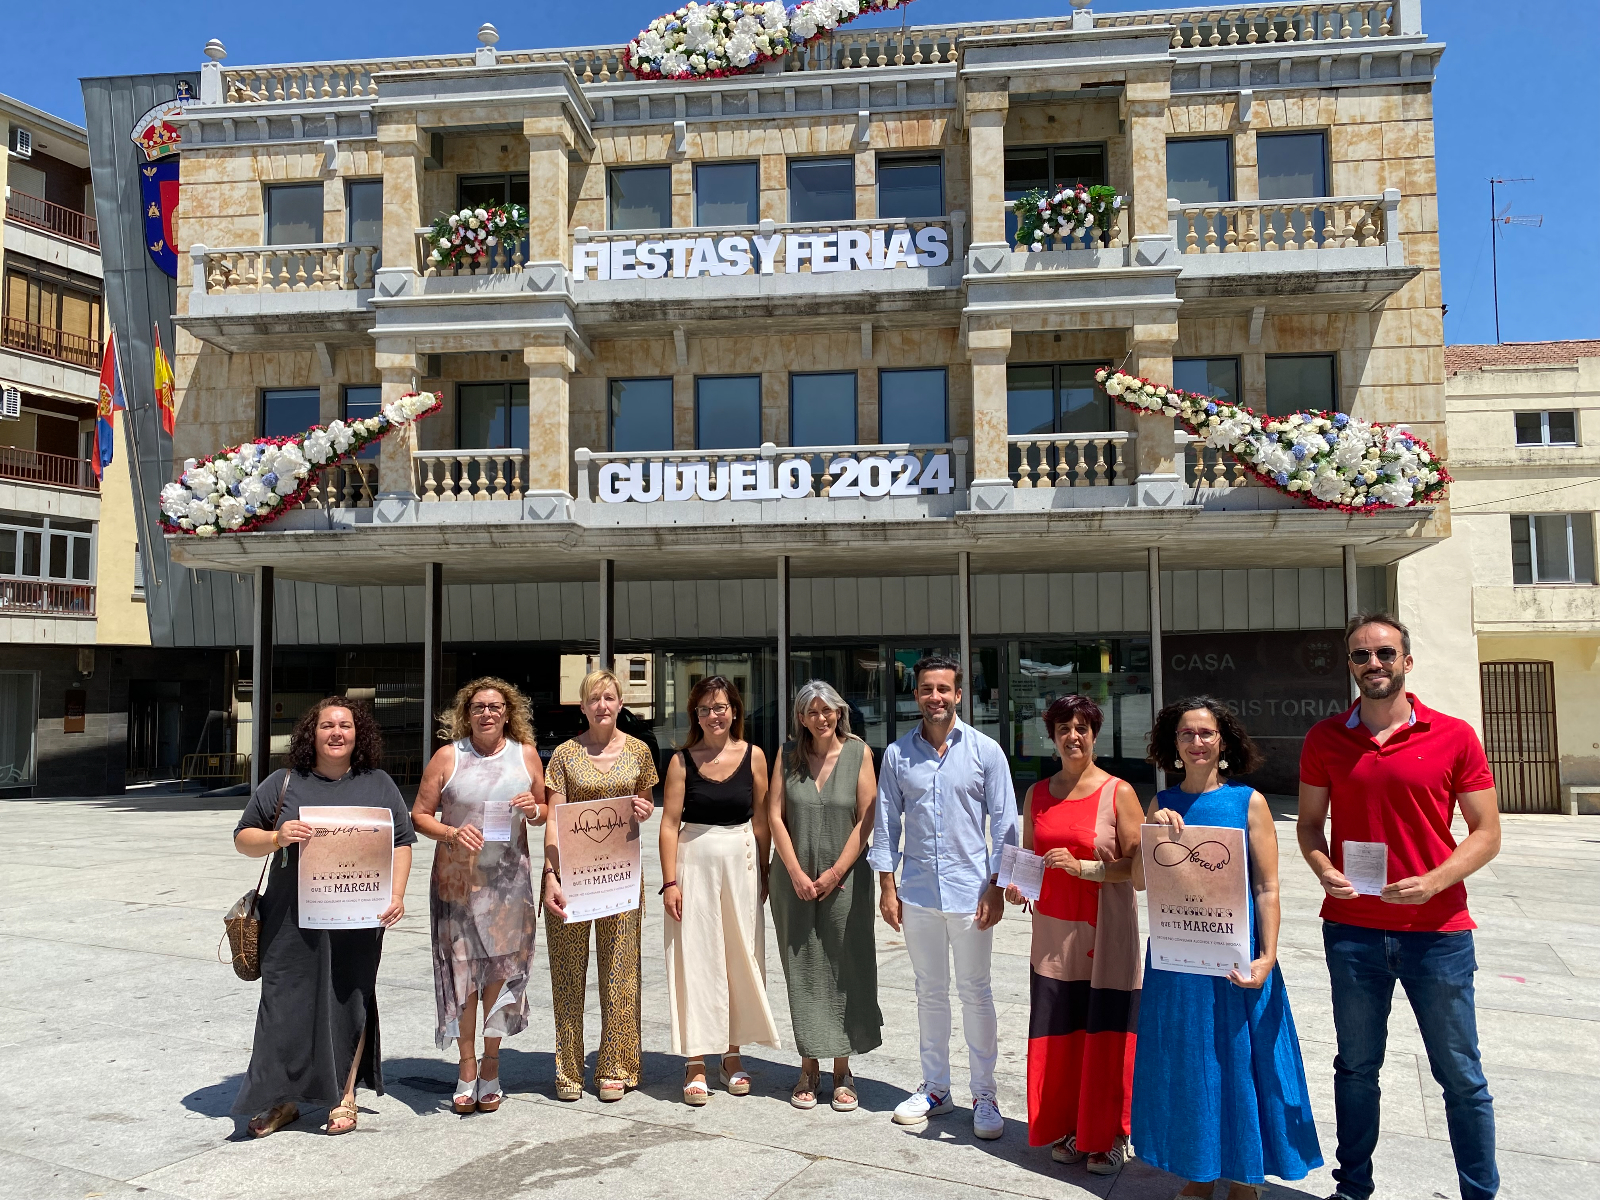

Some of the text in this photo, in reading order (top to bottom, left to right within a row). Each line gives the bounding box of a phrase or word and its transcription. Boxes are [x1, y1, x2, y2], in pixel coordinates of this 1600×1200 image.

[829, 454, 954, 498] 2024
[1171, 653, 1236, 671] CASA
[1189, 851, 1227, 872] forever
[313, 870, 380, 881] DECISIONES
[593, 871, 631, 885] MARCAN
[334, 882, 380, 893] MARCAN
[1185, 894, 1205, 902] HAY
[1161, 903, 1233, 918] DECISIONES
[1172, 921, 1181, 929] TE
[1183, 920, 1234, 934] MARCAN
